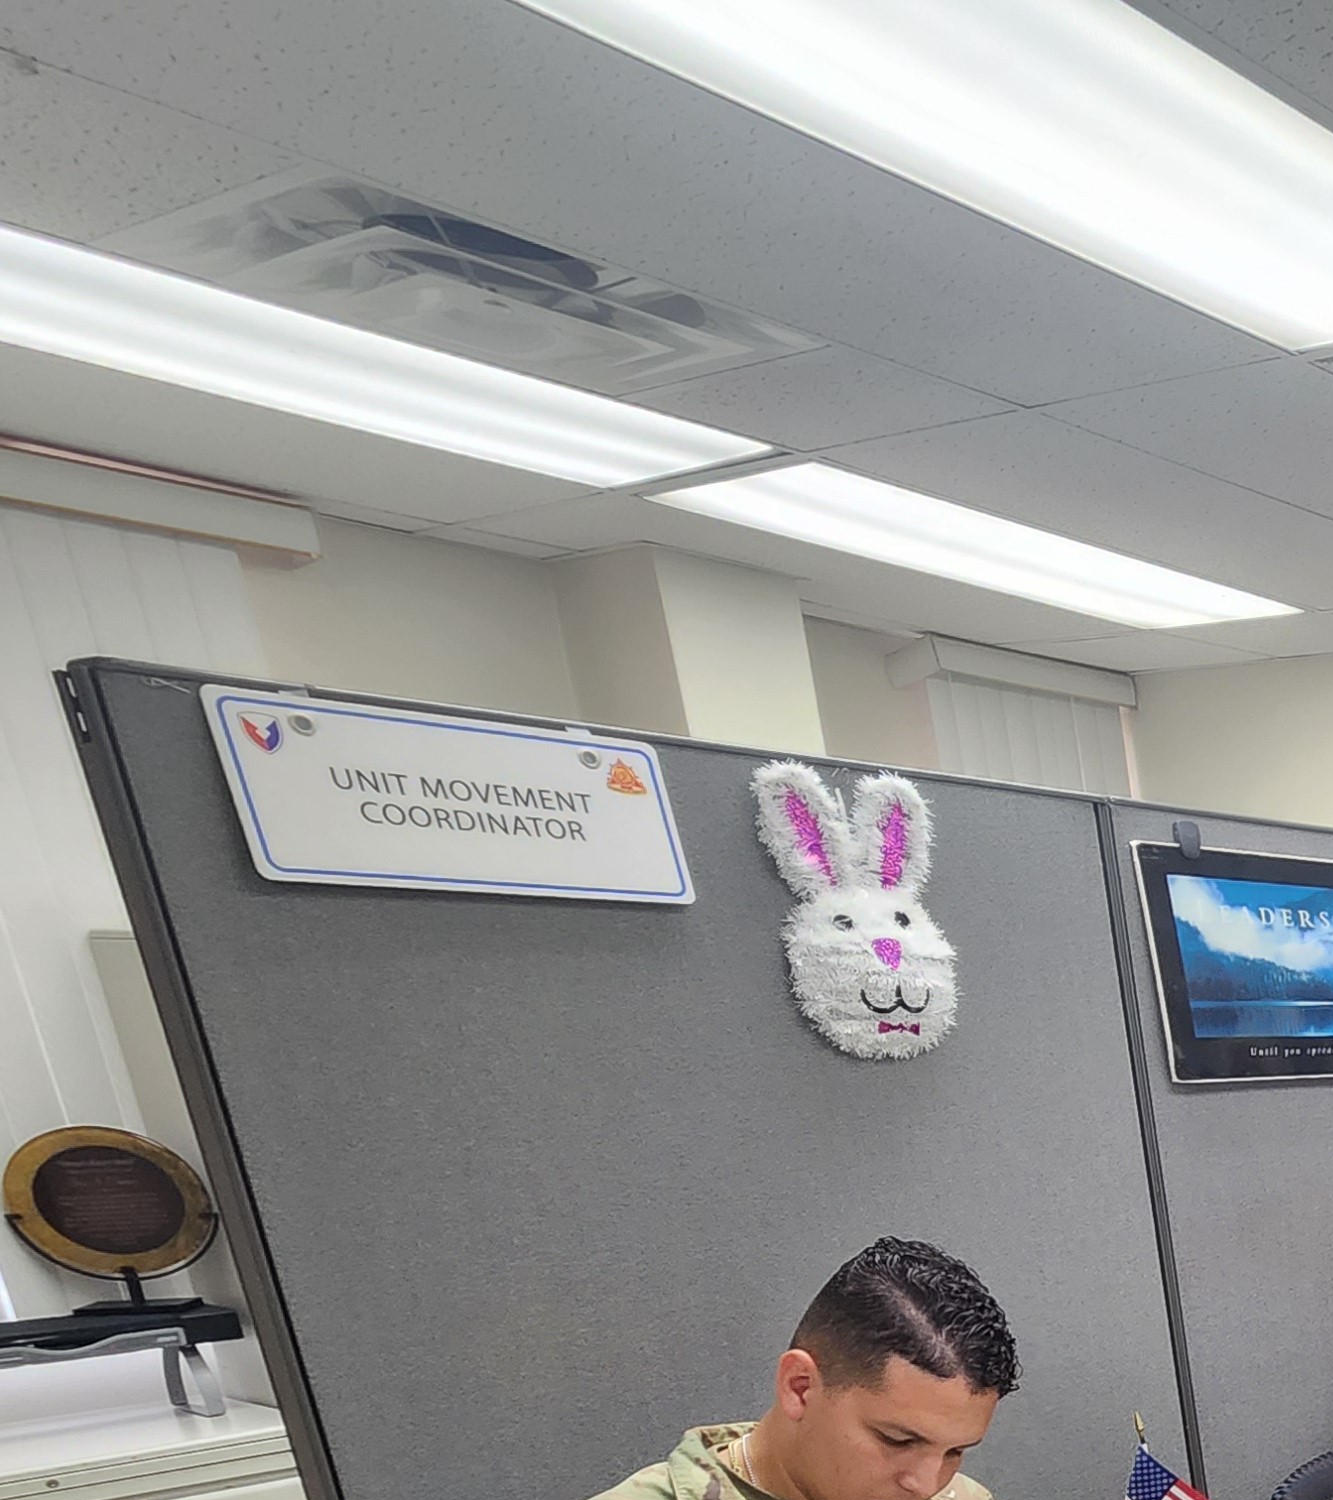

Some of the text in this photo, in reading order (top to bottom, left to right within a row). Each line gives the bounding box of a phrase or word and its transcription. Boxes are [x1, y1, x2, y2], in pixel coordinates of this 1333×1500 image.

[329, 765, 592, 815] UNIT MOVEMENT
[359, 801, 588, 842] COORDINATOR
[1249, 1046, 1279, 1058] Until
